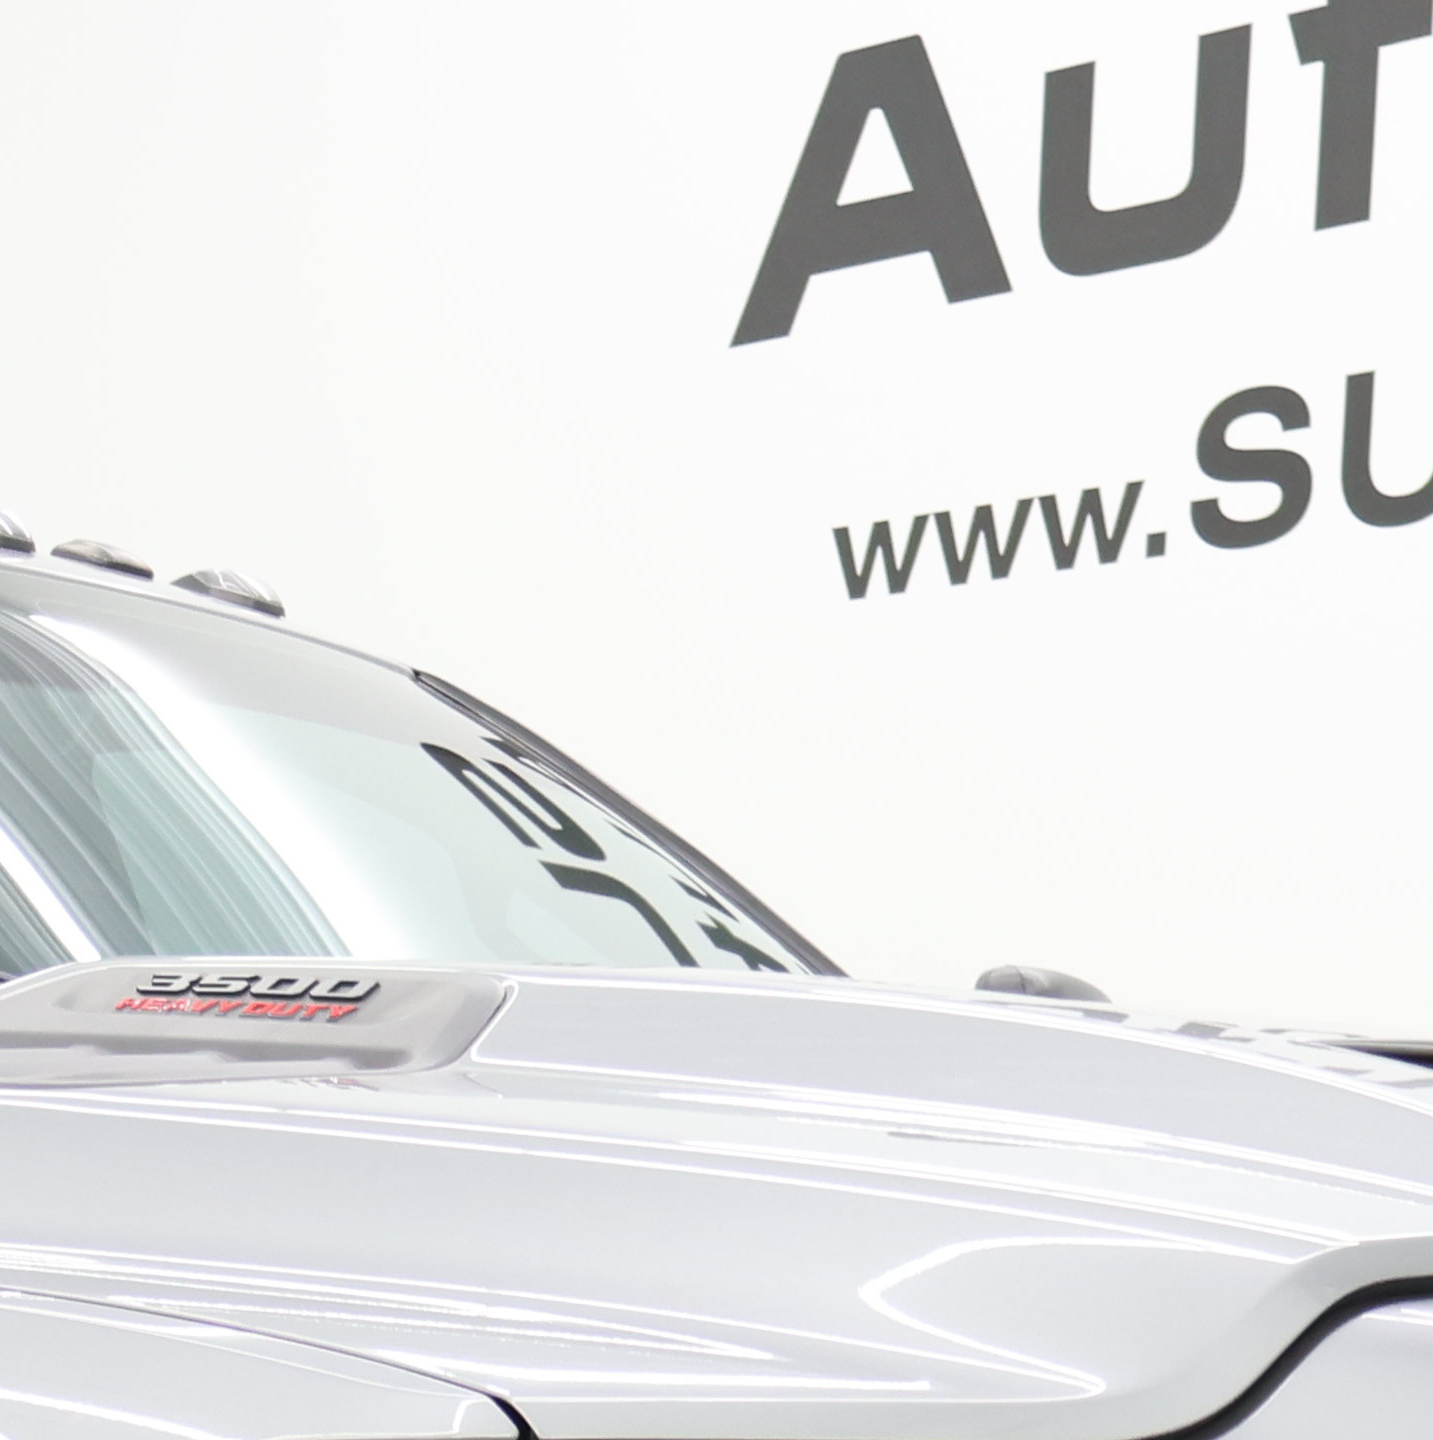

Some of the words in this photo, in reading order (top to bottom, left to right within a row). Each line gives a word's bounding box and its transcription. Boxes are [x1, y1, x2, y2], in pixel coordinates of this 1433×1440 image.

[135, 974, 381, 1001] 3500
[114, 996, 243, 1018] HEAVY
[238, 1001, 359, 1022] DUTY
